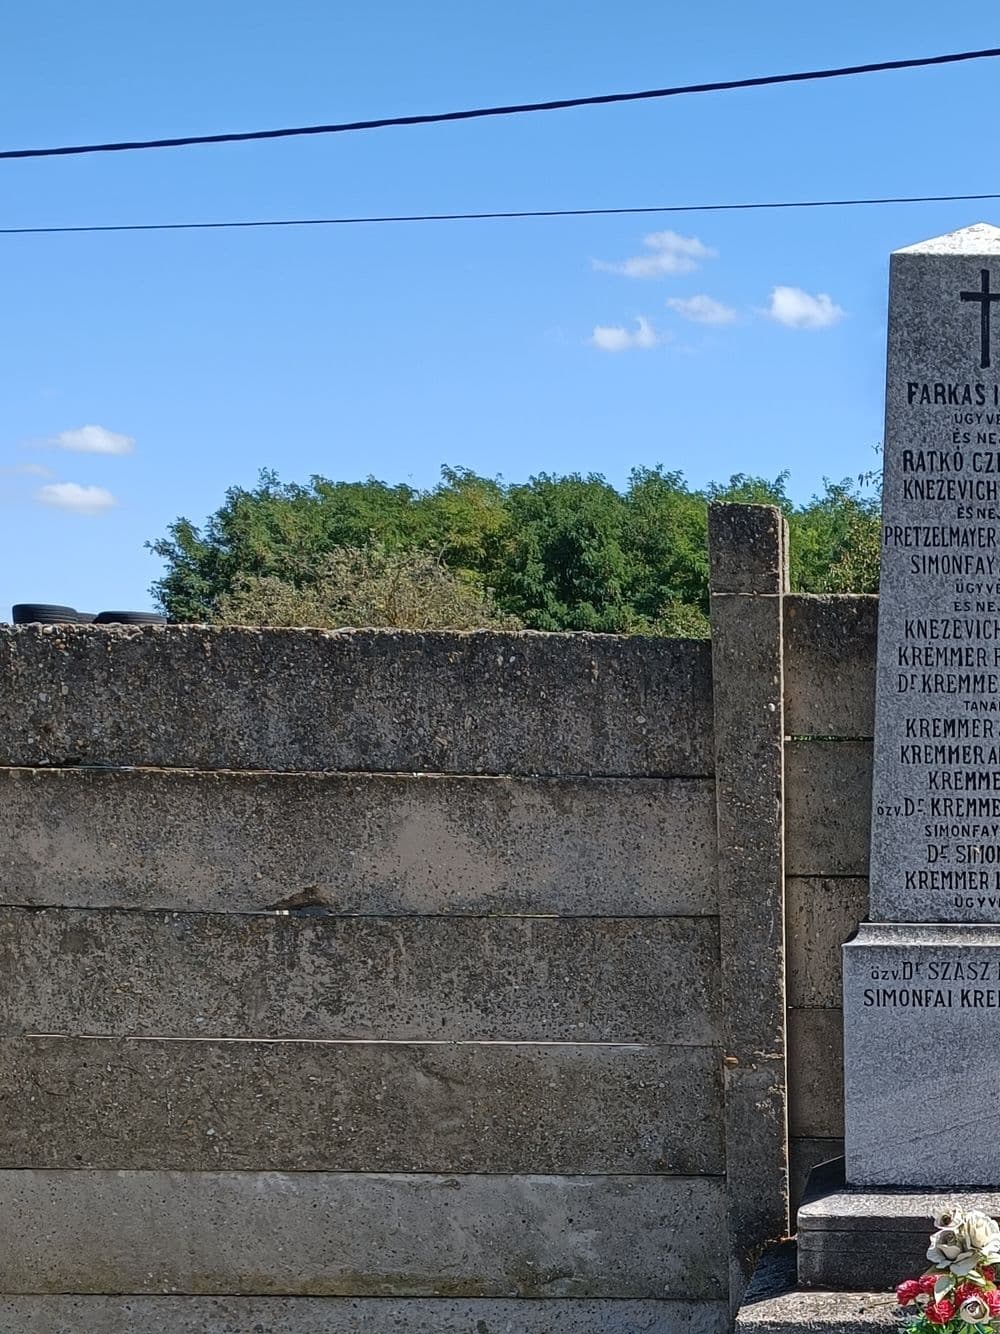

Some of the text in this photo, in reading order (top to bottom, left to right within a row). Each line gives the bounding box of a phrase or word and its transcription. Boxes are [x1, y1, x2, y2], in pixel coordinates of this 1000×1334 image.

[907, 382, 986, 405] FARKAS
[952, 428, 971, 444] ÉS
[902, 446, 964, 473] RATKÓ
[903, 479, 997, 501] KNEZEVICH
[957, 503, 973, 519] ÉS
[884, 526, 996, 548] PRETZELMAYER
[911, 554, 995, 575] SIMONFAY
[906, 718, 994, 739] KREMMER
[900, 745, 985, 765] KREMMER
[925, 825, 999, 838] SIMONFAY
[905, 871, 989, 890] KREMMER
[928, 955, 990, 981] SZÁSZ
[863, 988, 952, 1008] SIMONFAI
